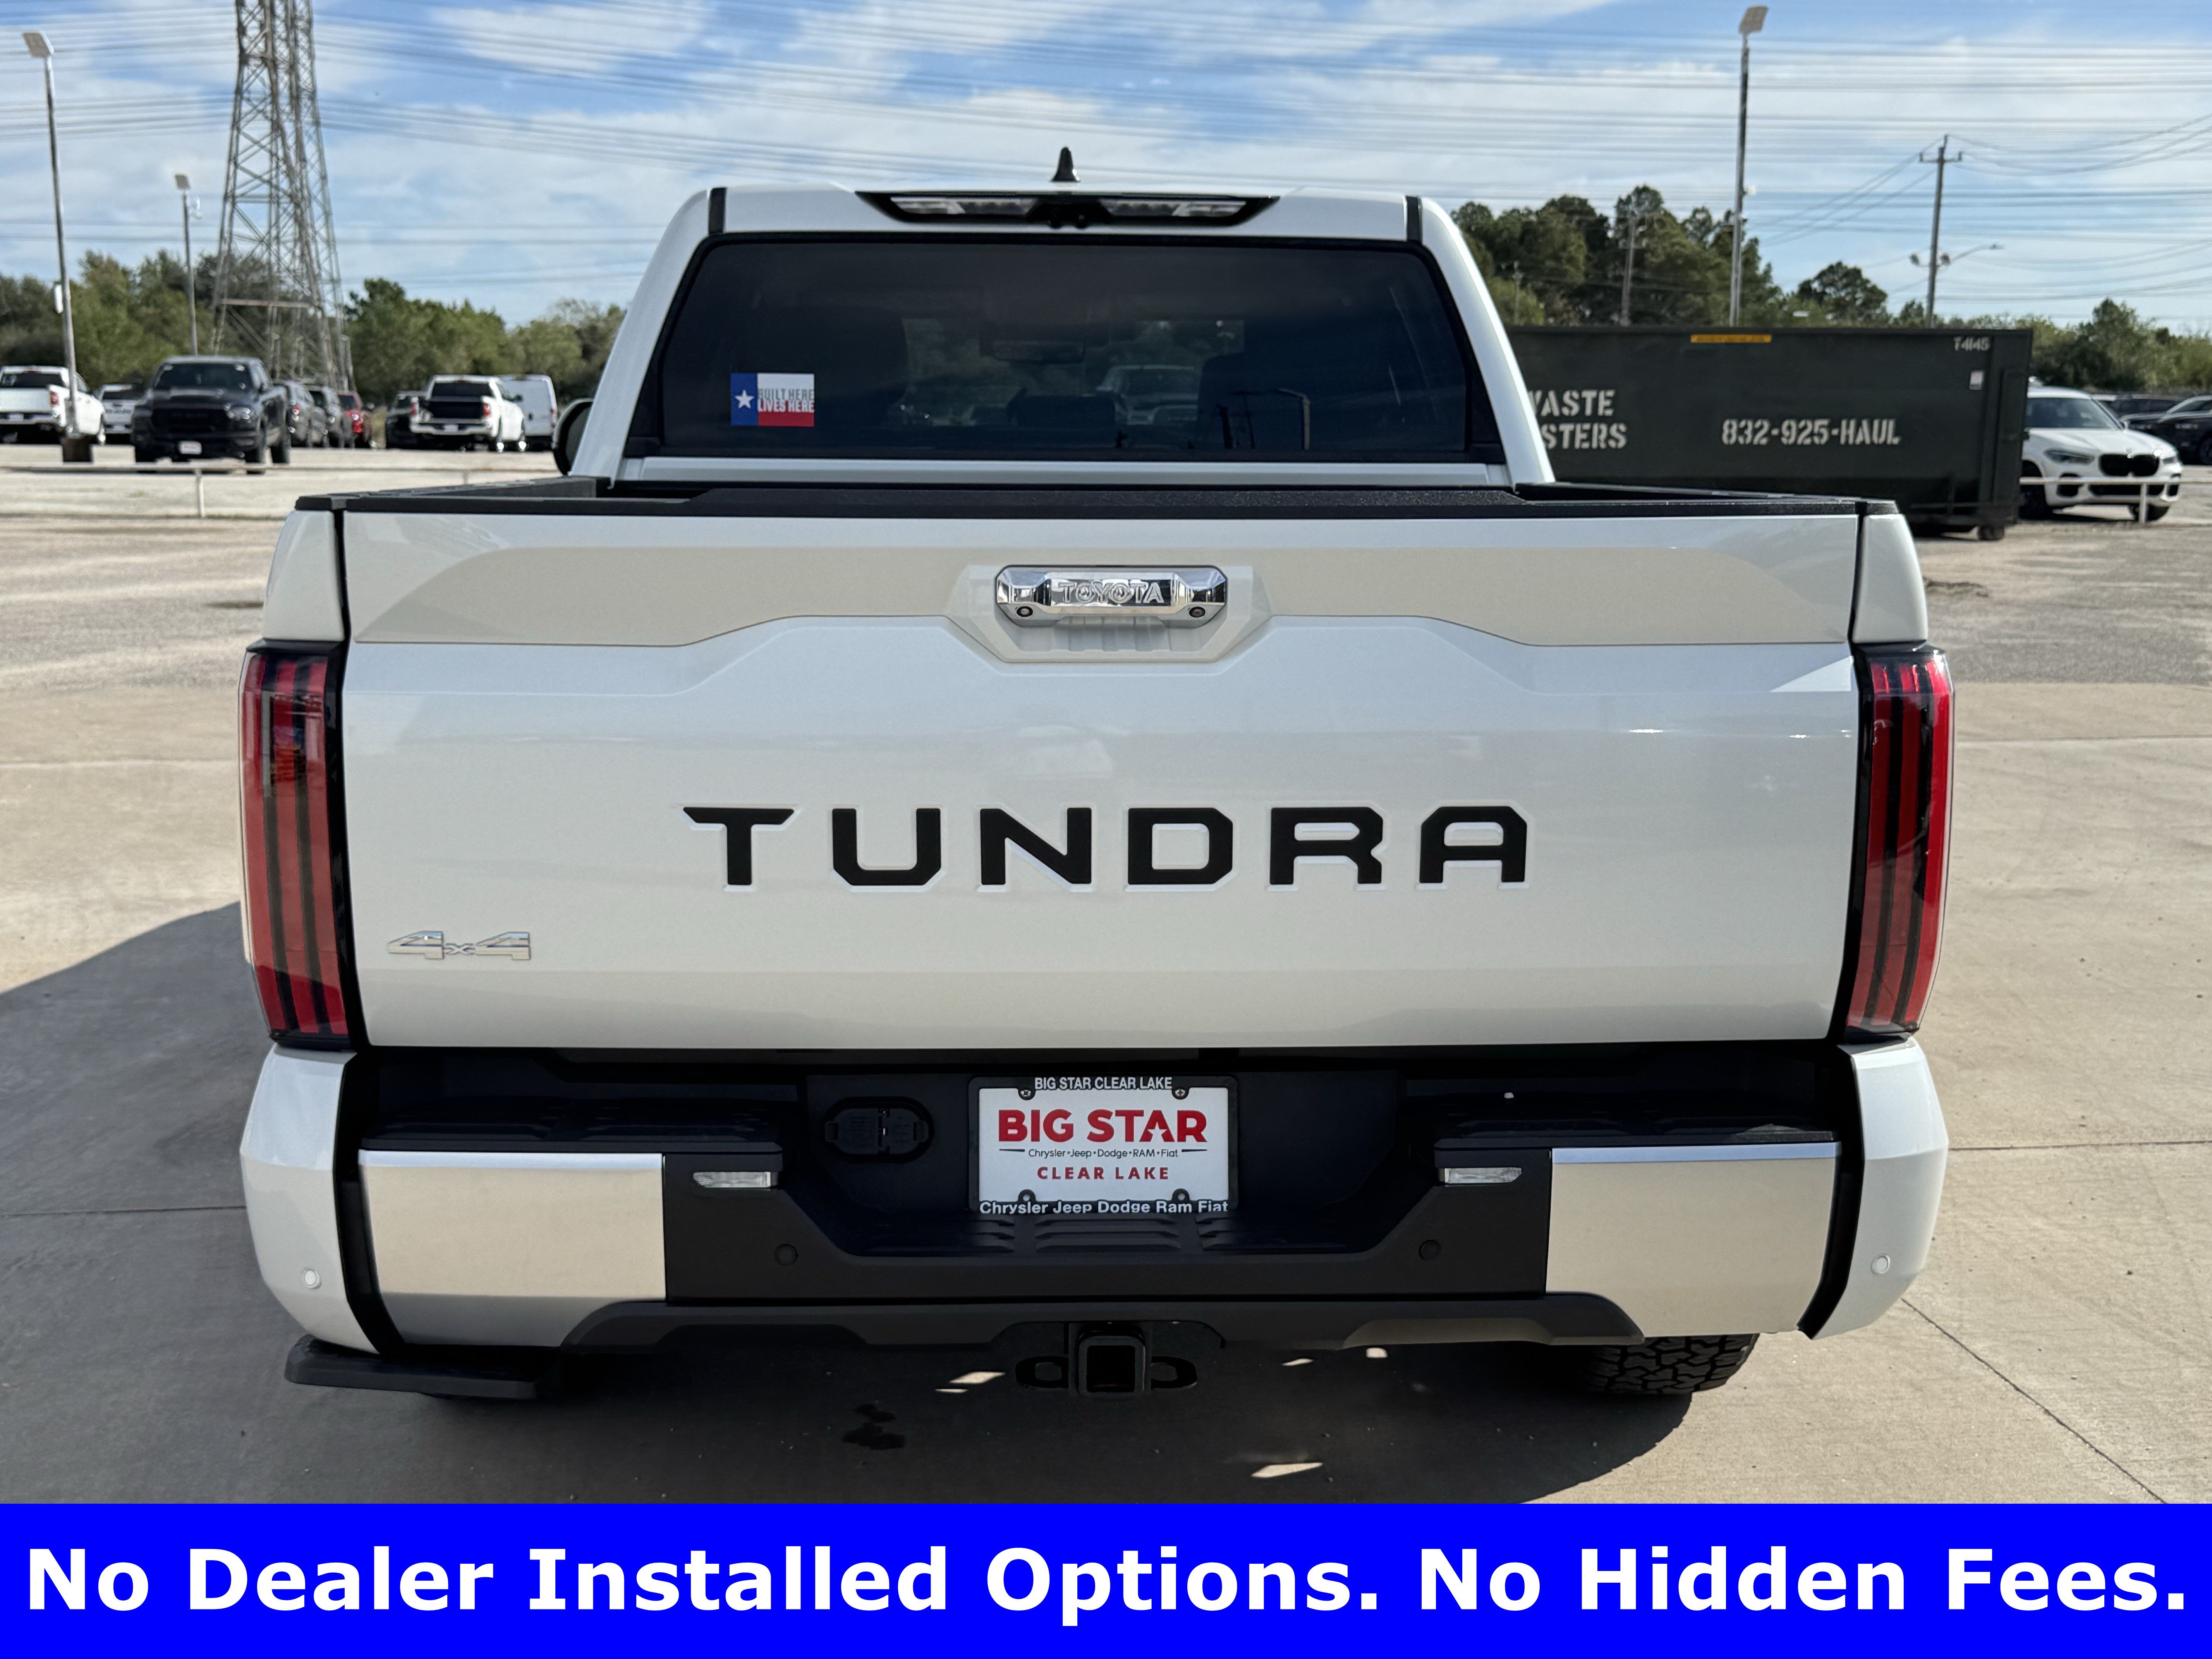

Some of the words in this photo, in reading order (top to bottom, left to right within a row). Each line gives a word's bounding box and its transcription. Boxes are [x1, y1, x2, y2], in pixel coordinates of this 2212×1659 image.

[758, 389, 785, 400] BUILT
[788, 389, 814, 400] HERE
[758, 400, 786, 412] LIVES
[788, 400, 814, 413] HERE
[1721, 419, 1901, 445] 832-925-HAUL
[1058, 581, 1164, 604] TOYOTA
[683, 805, 1528, 887] TUNDRA
[388, 930, 531, 960] 4x4
[1035, 1077, 1056, 1089] BIG
[1060, 1077, 1091, 1089] STAR
[1094, 1077, 1136, 1089] CLEAR
[1140, 1077, 1172, 1089] LAKE
[999, 1109, 1073, 1142] BIG
[1087, 1109, 1207, 1142] STAR
[1028, 1149, 1066, 1159] Chrysler
[1070, 1149, 1092, 1159] Jeep
[1097, 1149, 1128, 1159] Dodge
[1133, 1149, 1155, 1157] RAM
[1037, 1166, 1104, 1180] CLEAR
[1116, 1166, 1169, 1180] LAKE
[979, 1201, 1048, 1214] Chrysler
[1053, 1201, 1092, 1214] Jeep
[1097, 1201, 1150, 1214] Dodge
[1156, 1201, 1192, 1213] Ram
[1198, 1200, 1228, 1212] Fiat
